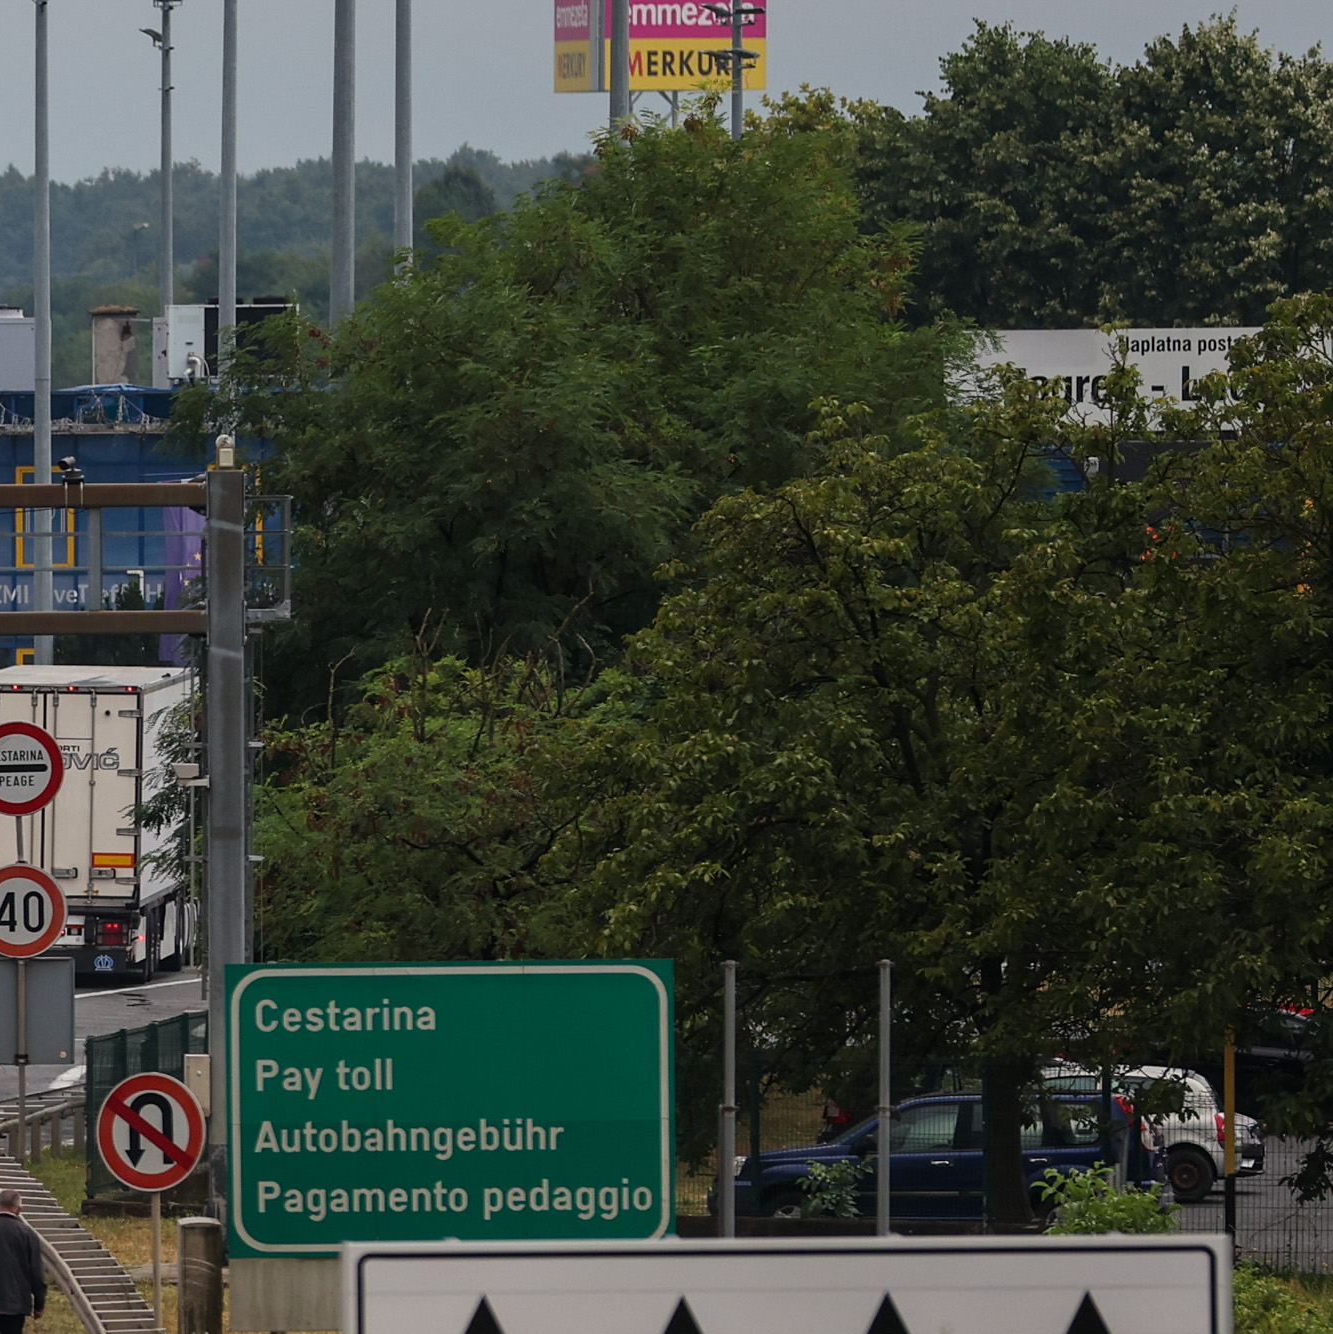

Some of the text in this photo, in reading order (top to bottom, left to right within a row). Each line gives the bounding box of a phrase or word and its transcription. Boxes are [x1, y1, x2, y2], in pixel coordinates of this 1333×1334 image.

[0, 775, 35, 787] PEAGE
[255, 998, 436, 1032] Cestarina
[256, 1057, 393, 1100] Pay toll
[255, 1118, 565, 1161] Autobahngebühr
[257, 1177, 653, 1222] Pagamento pedaggio
